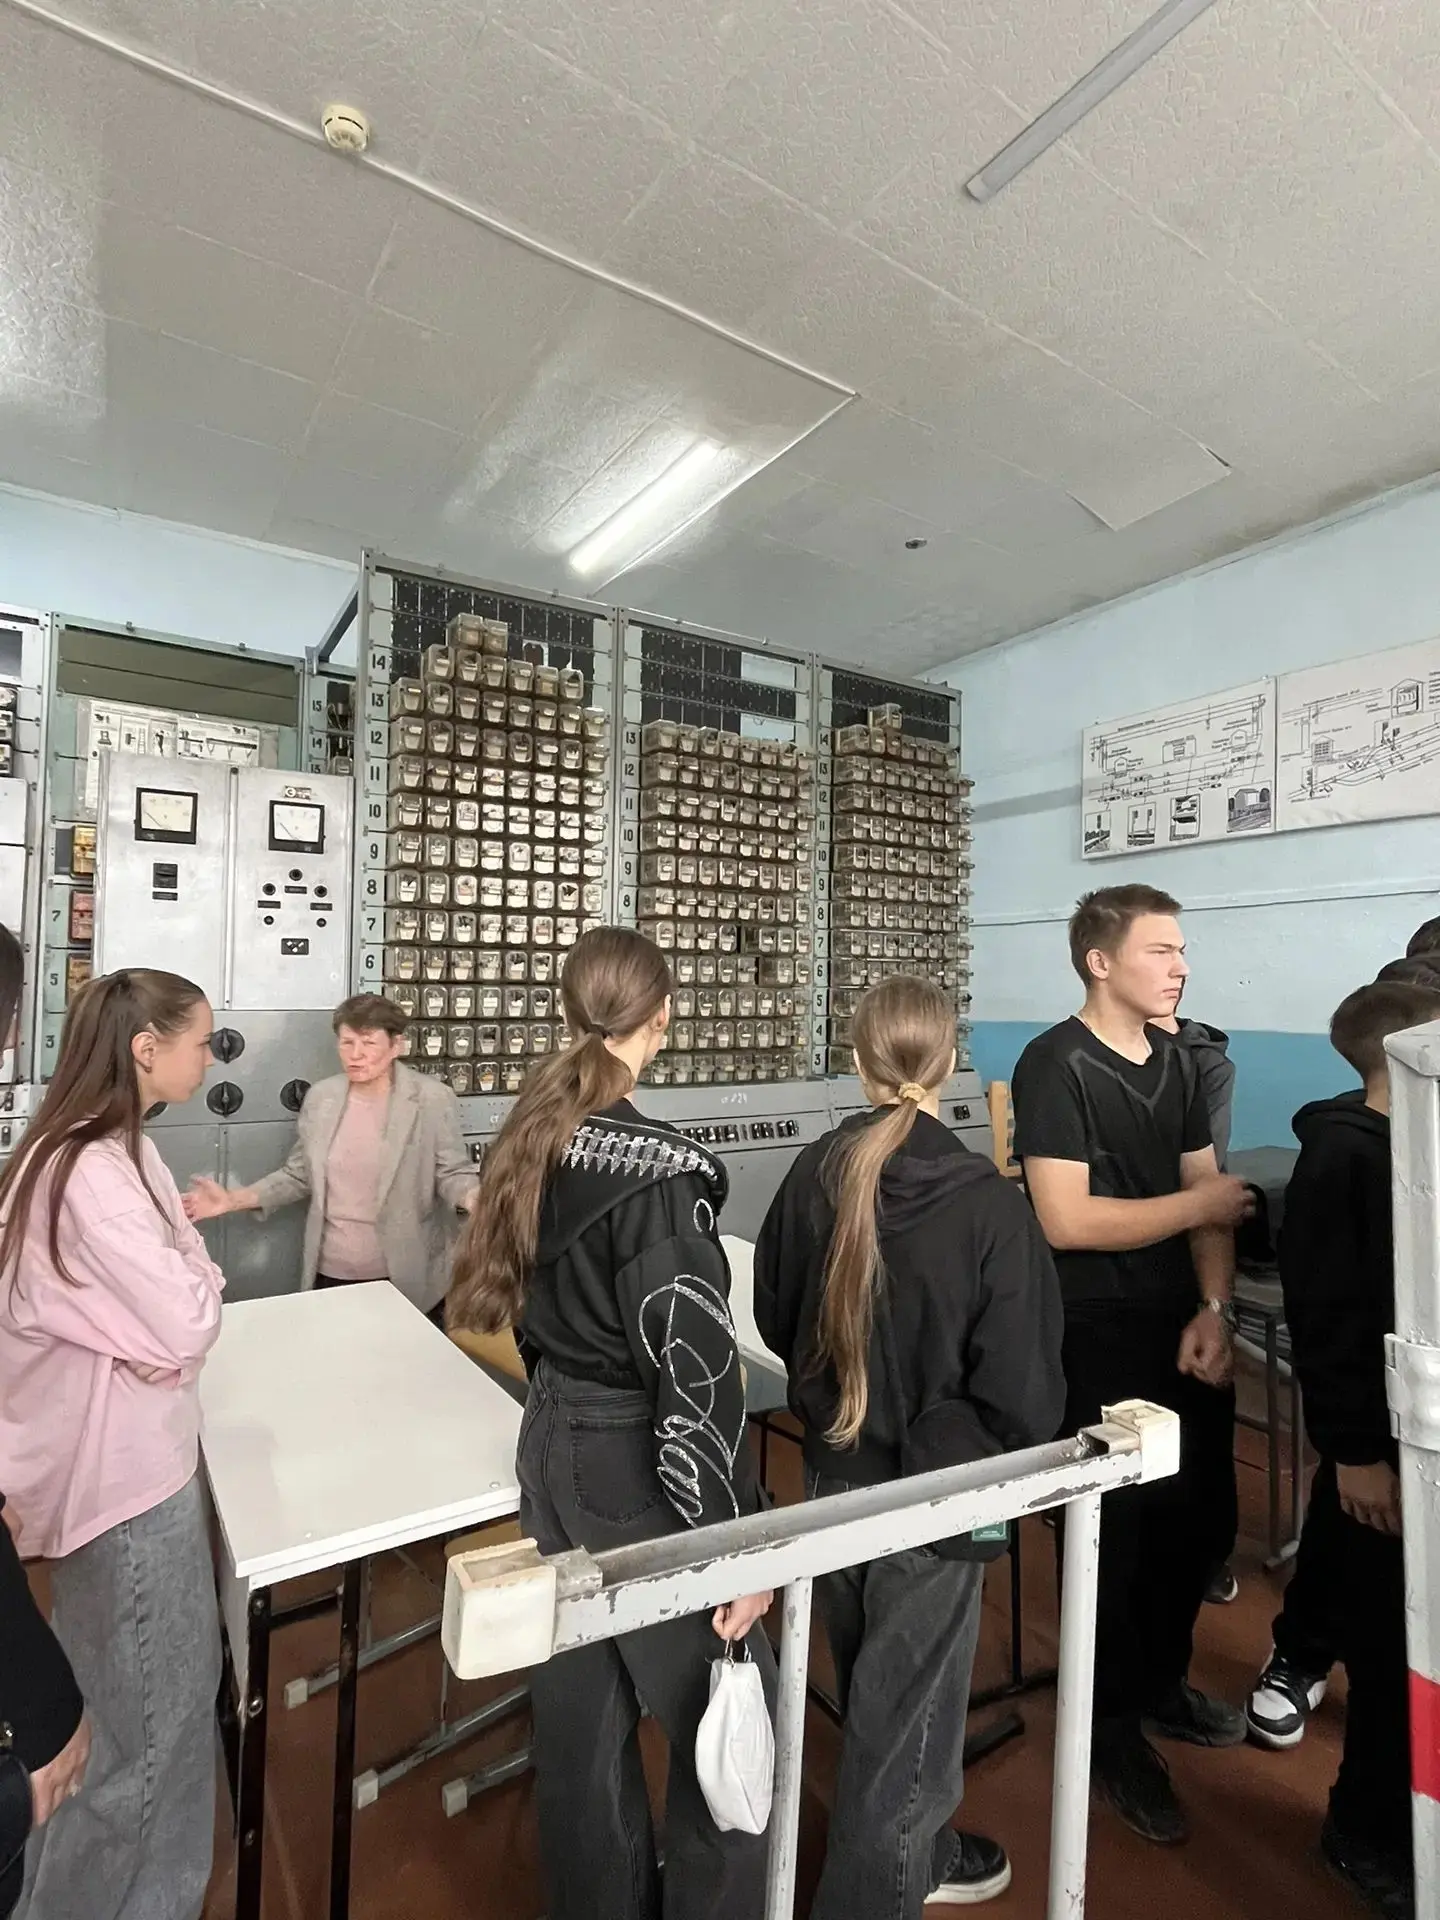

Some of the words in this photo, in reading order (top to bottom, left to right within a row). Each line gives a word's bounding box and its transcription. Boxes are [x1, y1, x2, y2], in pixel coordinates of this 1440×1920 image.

[373, 654, 385, 669] 14
[313, 700, 322, 712] 15
[372, 693, 384, 707] 13
[313, 738, 322, 748] 14
[371, 731, 382, 744] 12
[625, 731, 637, 745] 13
[819, 733, 829, 746] 14
[371, 766, 379, 780] 11
[624, 763, 635, 777] 12
[819, 762, 828, 775] 13
[818, 790, 828, 803] 12
[625, 797, 633, 810] 11
[370, 804, 381, 818] 10
[819, 820, 826, 831] 11
[623, 829, 634, 842] 10
[371, 844, 378, 859] 9
[818, 849, 827, 862] 10
[624, 861, 632, 876] 9
[367, 879, 376, 895] 8
[818, 877, 825, 891] 9
[622, 894, 631, 908] 8
[52, 910, 61, 921] 7
[817, 906, 825, 921] 8
[367, 918, 375, 930] 7
[817, 936, 824, 949] 7
[366, 955, 374, 969] 6
[816, 964, 823, 978] 6
[50, 973, 58, 985] 5
[816, 994, 823, 1007] 5
[815, 1024, 823, 1036] 4
[46, 1035, 54, 1048] 3
[814, 1053, 821, 1066] 3
